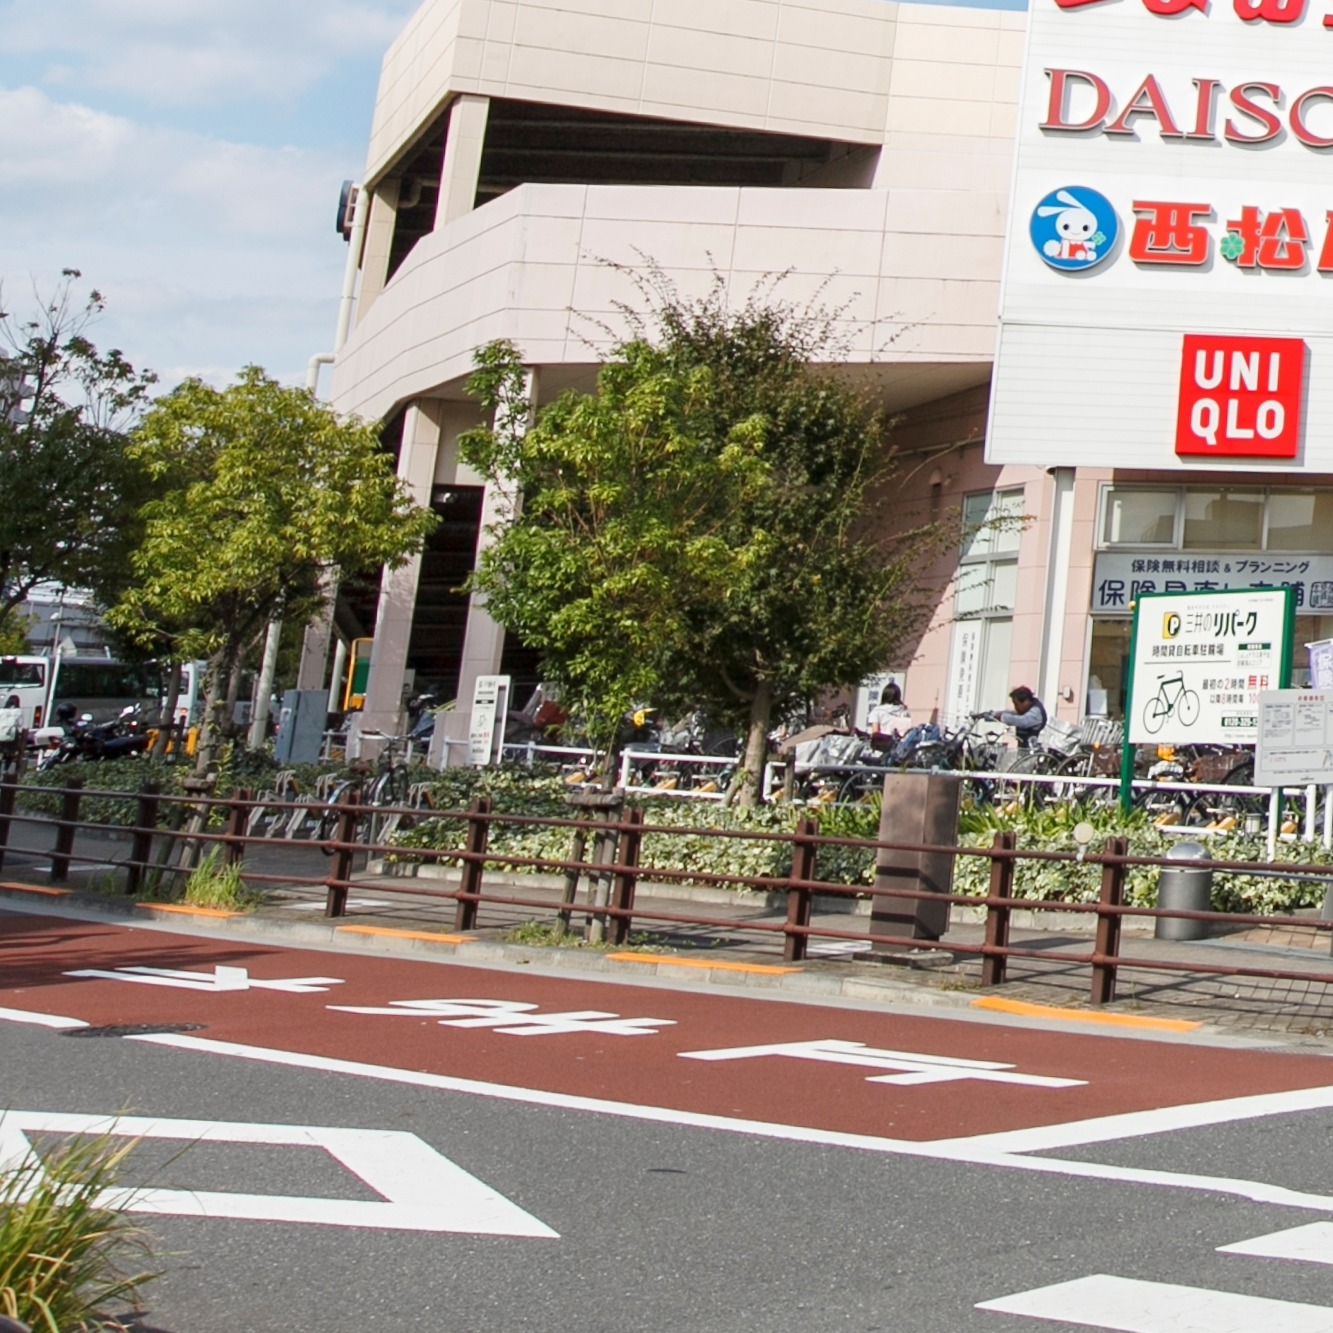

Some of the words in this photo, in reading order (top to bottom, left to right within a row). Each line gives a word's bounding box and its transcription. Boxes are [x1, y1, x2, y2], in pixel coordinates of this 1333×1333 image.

[1194, 349, 1281, 392] UNI
[1190, 397, 1285, 446] QLO
[1131, 559, 1220, 574] 保険無料相談
[1224, 562, 1231, 573] &
[1185, 609, 1258, 637] 三井のリパーク
